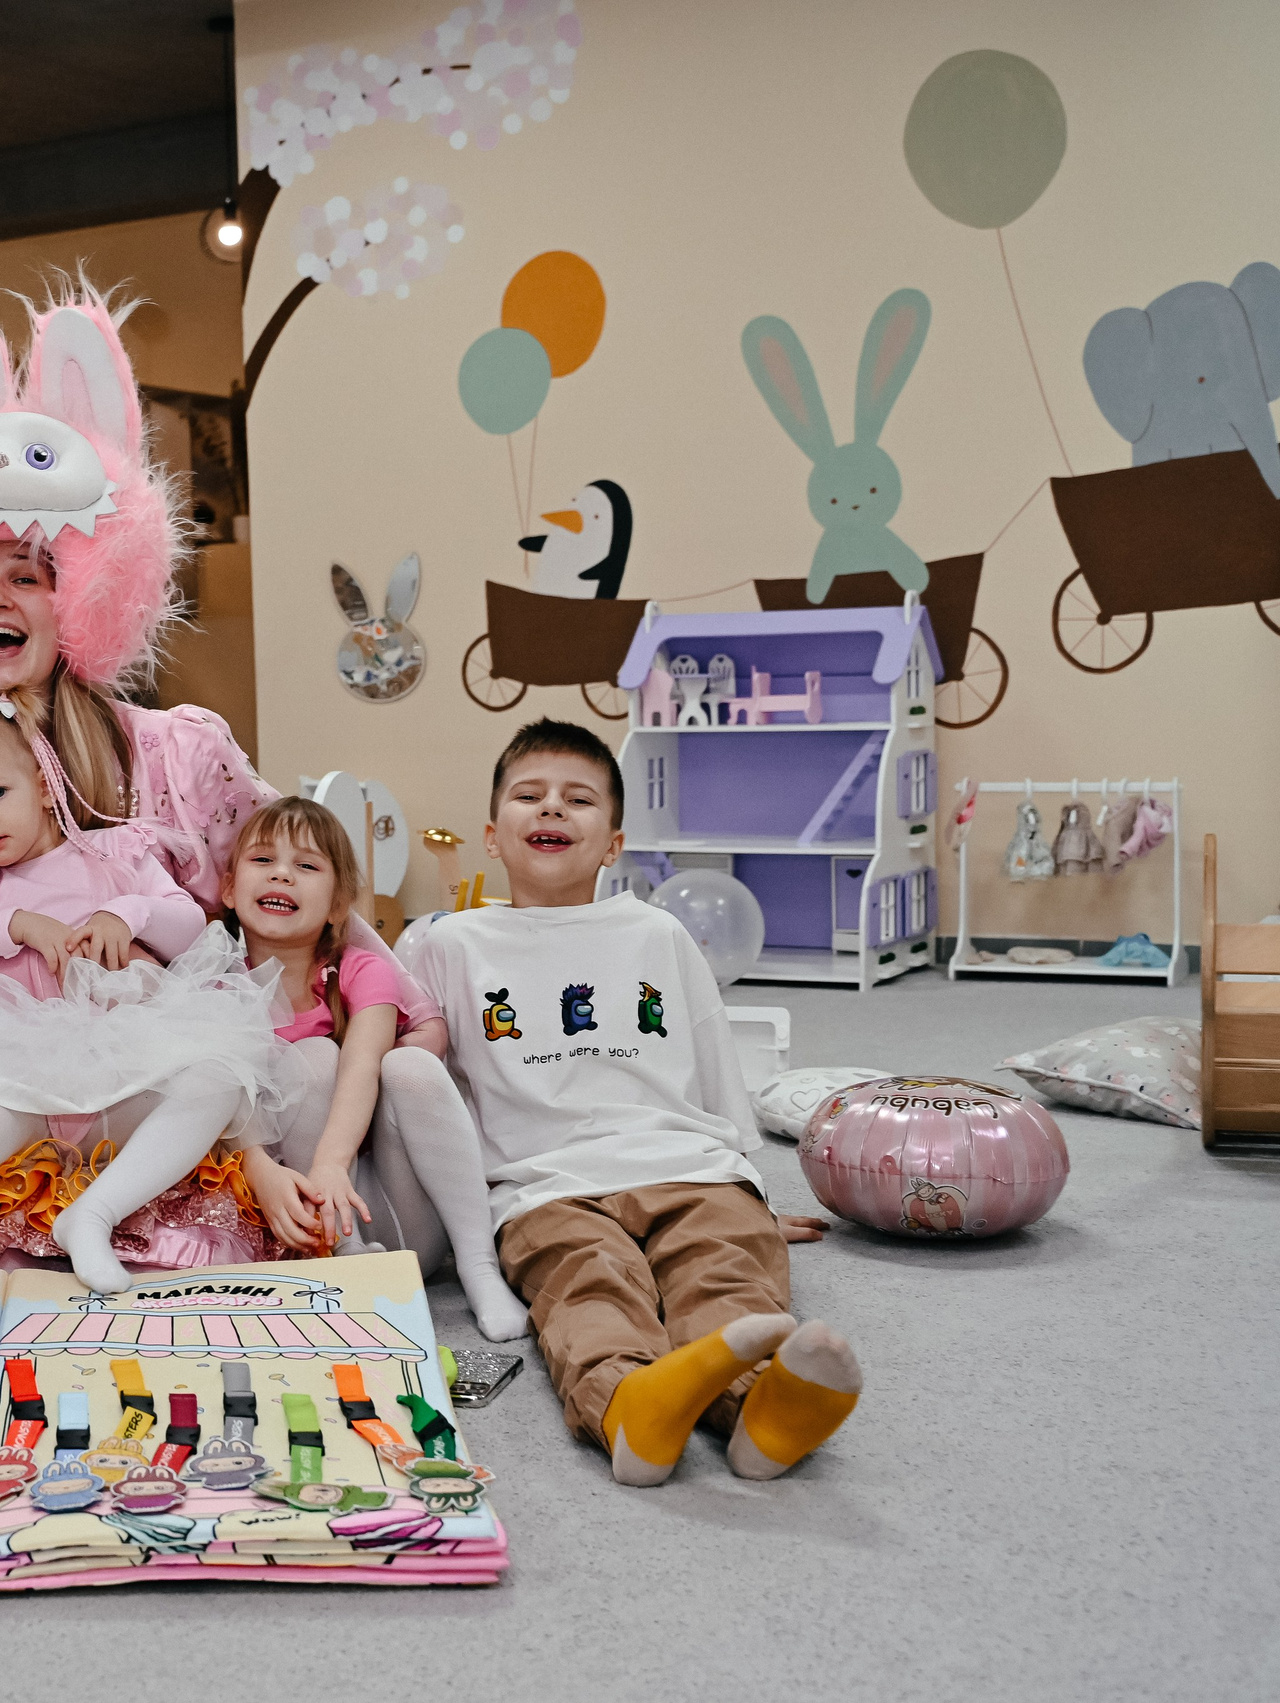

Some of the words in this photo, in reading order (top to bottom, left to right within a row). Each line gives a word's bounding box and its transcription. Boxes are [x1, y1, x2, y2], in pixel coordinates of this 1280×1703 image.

[523, 1052, 562, 1065] where
[569, 1046, 600, 1057] were
[608, 1047, 639, 1059] you?
[871, 1094, 998, 1119] Labubu
[130, 1295, 282, 1308] АКСЕССУАРОВ
[137, 1285, 276, 1299] МАГАЗИН
[123, 1411, 143, 1438] STERS
